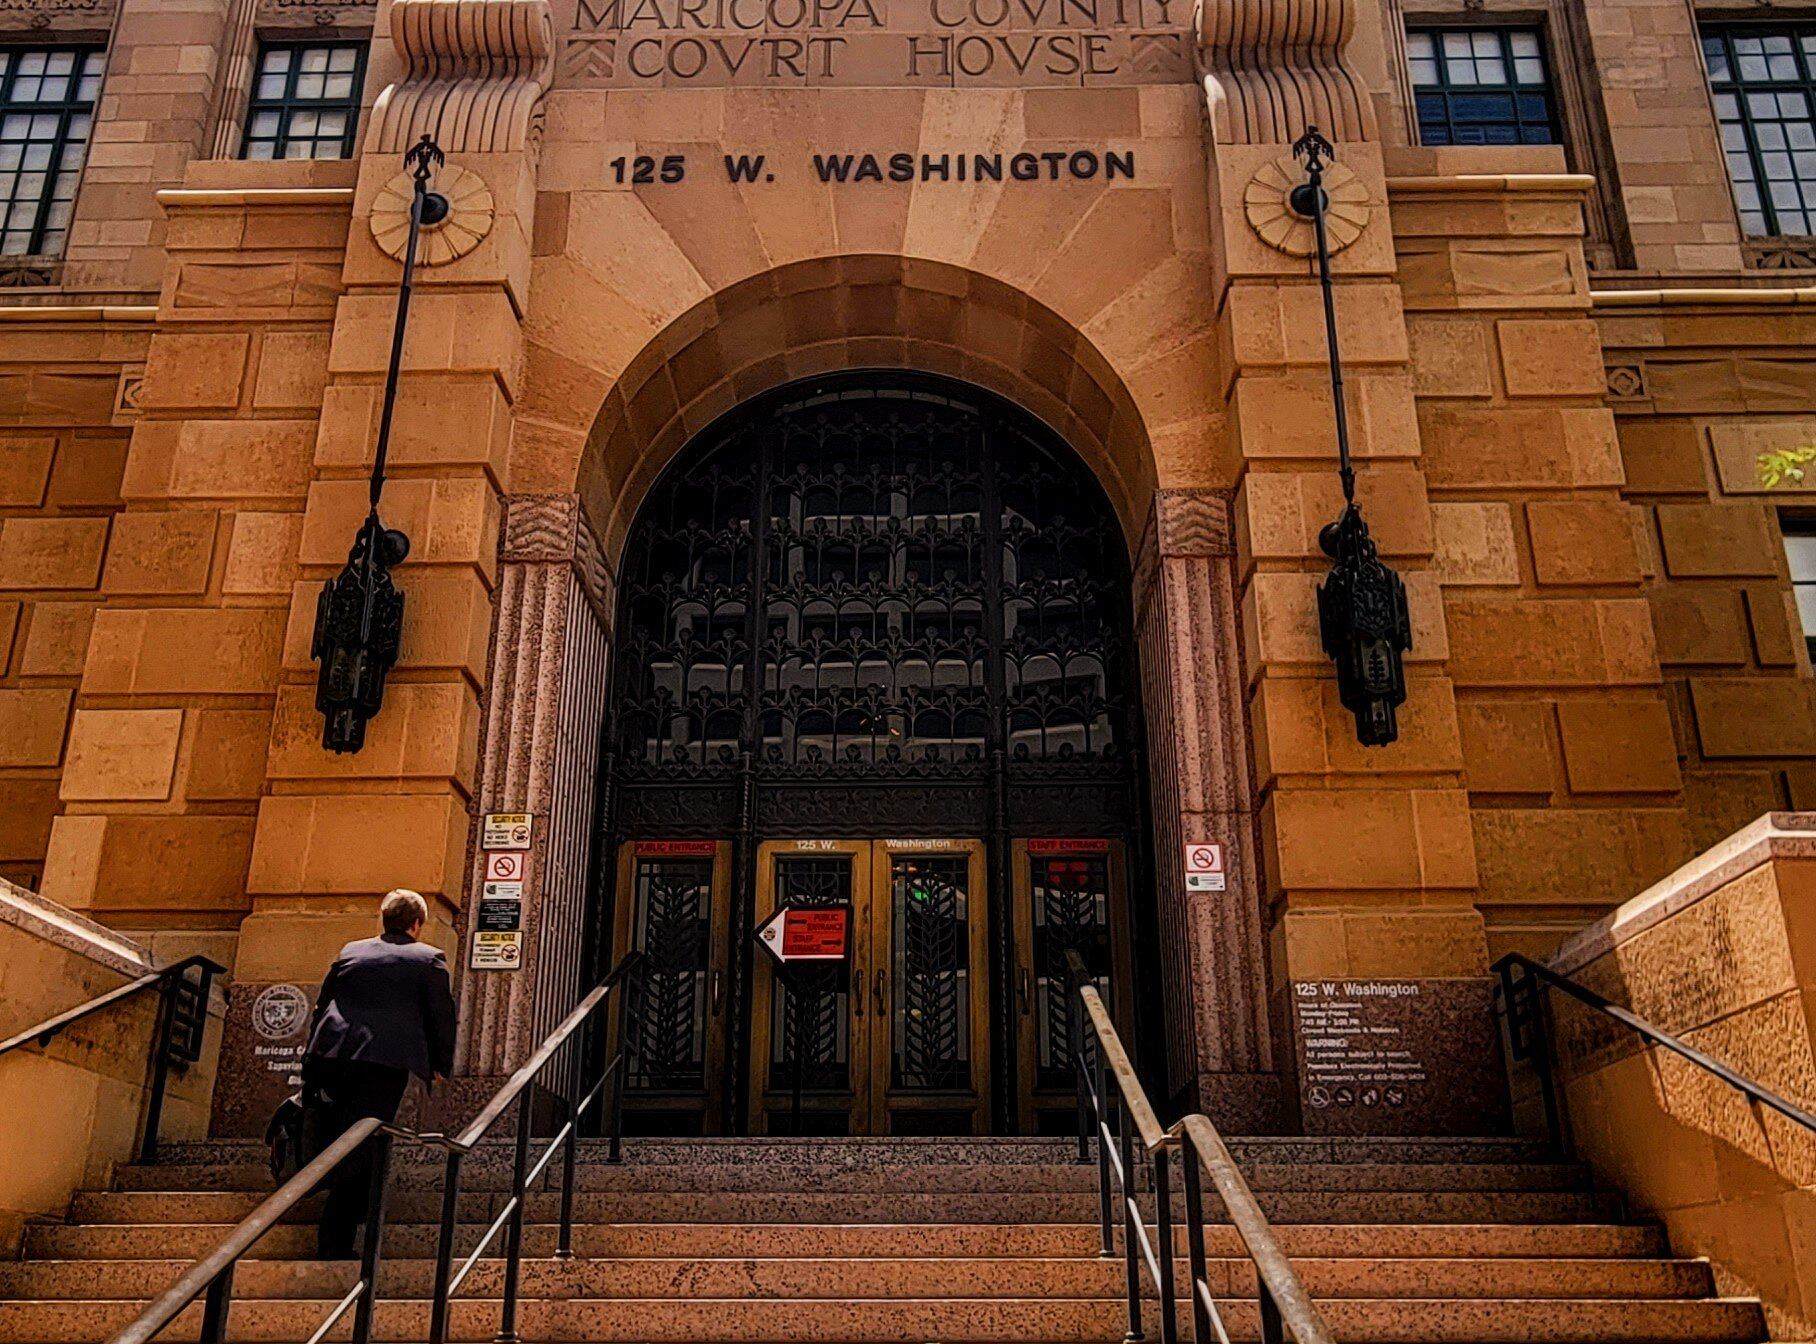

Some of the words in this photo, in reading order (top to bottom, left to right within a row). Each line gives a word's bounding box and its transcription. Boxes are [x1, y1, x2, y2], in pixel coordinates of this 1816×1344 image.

[609, 155, 685, 184] 125
[725, 154, 776, 183] W.
[813, 151, 1136, 181] WASHINGTON
[635, 842, 667, 852] PUBLIC
[669, 842, 715, 852] ENTRANCE
[796, 840, 817, 850] 125
[819, 840, 836, 850] W.
[885, 838, 951, 850] Washington
[1029, 840, 1056, 850] STAFF
[1059, 840, 1107, 850] ENTRANCE
[814, 913, 838, 922] PUBLIC
[807, 922, 843, 931] ENTRANCE
[793, 934, 814, 943] STAFF
[1295, 983, 1317, 996] 125
[1321, 983, 1339, 996] W.
[1343, 982, 1419, 998] Washington
[255, 1045, 294, 1056] Maricopa
